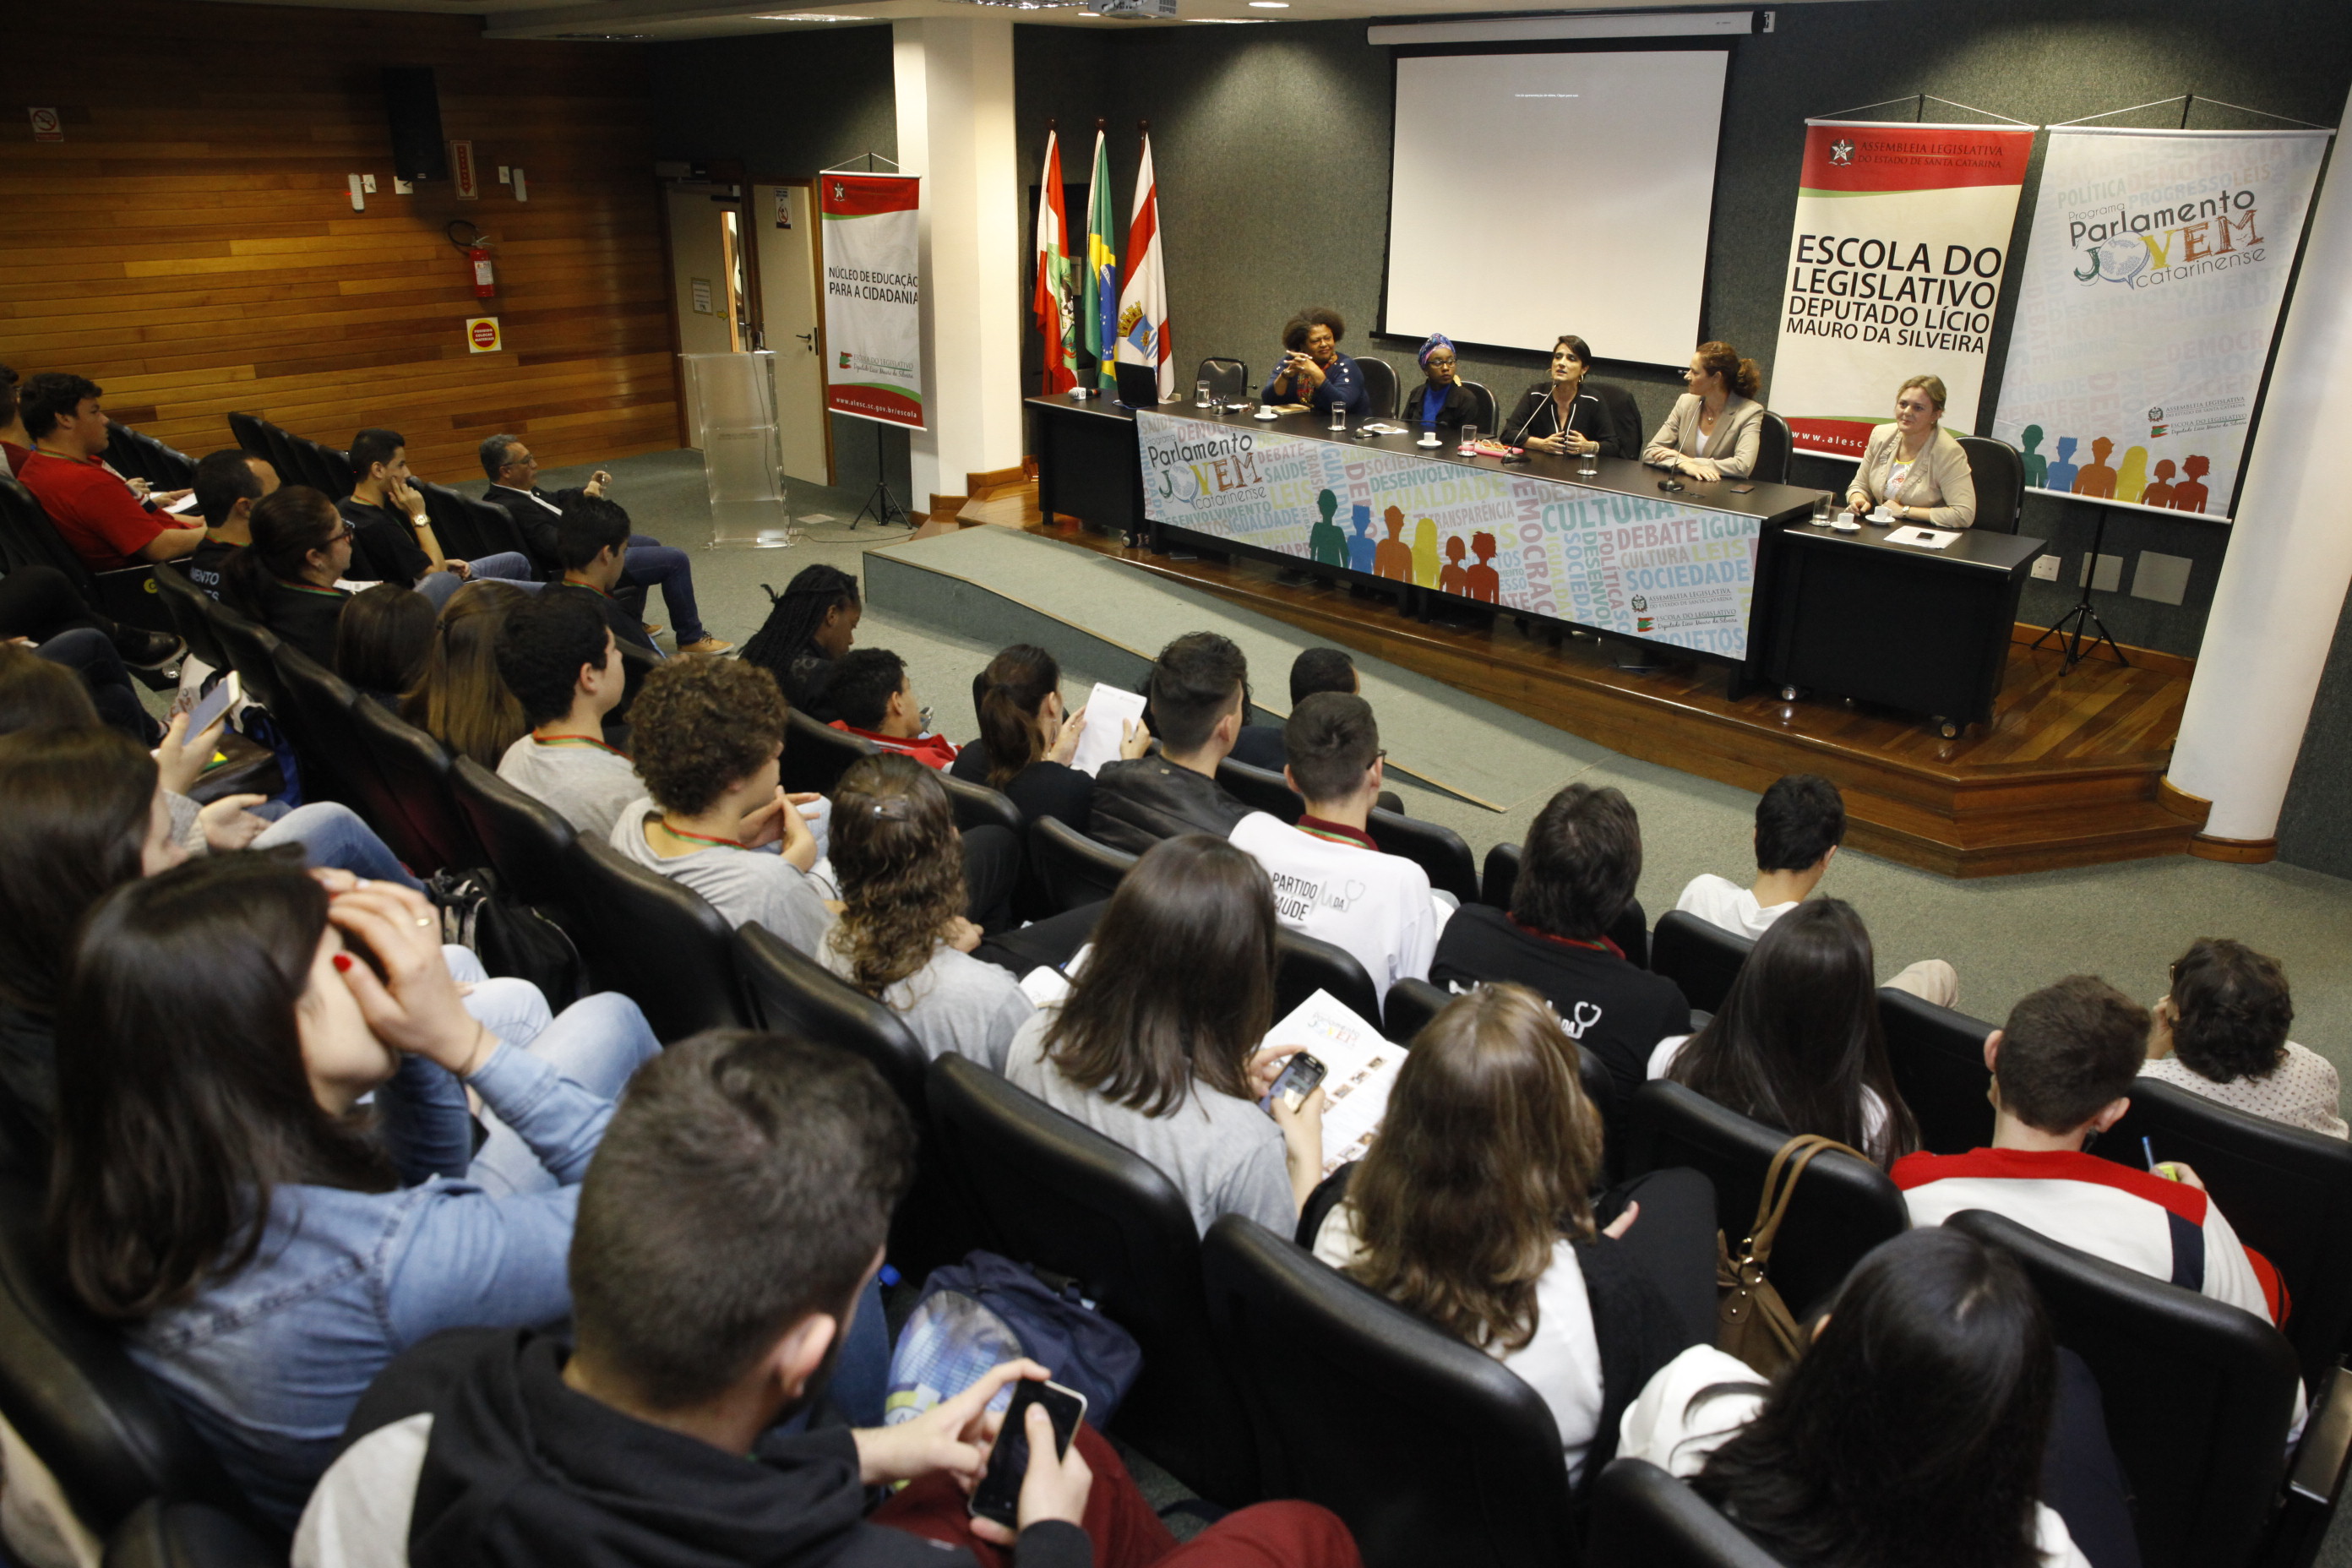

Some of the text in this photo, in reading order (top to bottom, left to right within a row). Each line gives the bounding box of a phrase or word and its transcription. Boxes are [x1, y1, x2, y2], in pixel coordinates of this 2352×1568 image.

[1859, 141, 2003, 156] ASSEMBLEIA LEGISLATIVA
[1859, 155, 1871, 163] DO
[1875, 155, 1908, 165] ESTADO
[1924, 158, 1952, 166] SANTA
[1955, 160, 2001, 168] CATARINA
[2068, 202, 2125, 222] Programa
[2070, 190, 2255, 247] Parlamento
[1797, 234, 2001, 278] ESCOLA DO
[2136, 248, 2266, 288] catarinense
[829, 266, 918, 289] NÚCLEO DE EDUCAÇÃO
[1792, 267, 1995, 309] LEGISLATIVO
[830, 281, 918, 305] PARA A CIDADANIA
[1789, 296, 1990, 334] DEPUTADO LÍCIO
[1786, 317, 1984, 354] MAURO DA SILVEIRA
[1147, 433, 1252, 467] Parlamento
[1258, 443, 1304, 464] DEBATE
[1265, 460, 1309, 483] SAÚDE
[1195, 486, 1267, 509] catarinense
[1269, 479, 1315, 510] LEIS
[1228, 508, 1302, 534] IGUALDADE
[1542, 496, 1675, 533] CULTURA
[1617, 520, 1700, 551] DEBATE
[1621, 546, 1690, 570] CULTURA
[1692, 539, 1747, 563] LEIS
[1625, 559, 1750, 591] SOCIEDADE
[1649, 588, 1732, 602] ASSEMBLEIA LEGISLATIVA
[1696, 608, 1737, 618] LEGISLATIVO
[1272, 873, 1318, 899] PARTIDO
[1274, 896, 1345, 922] AÚDE DA
